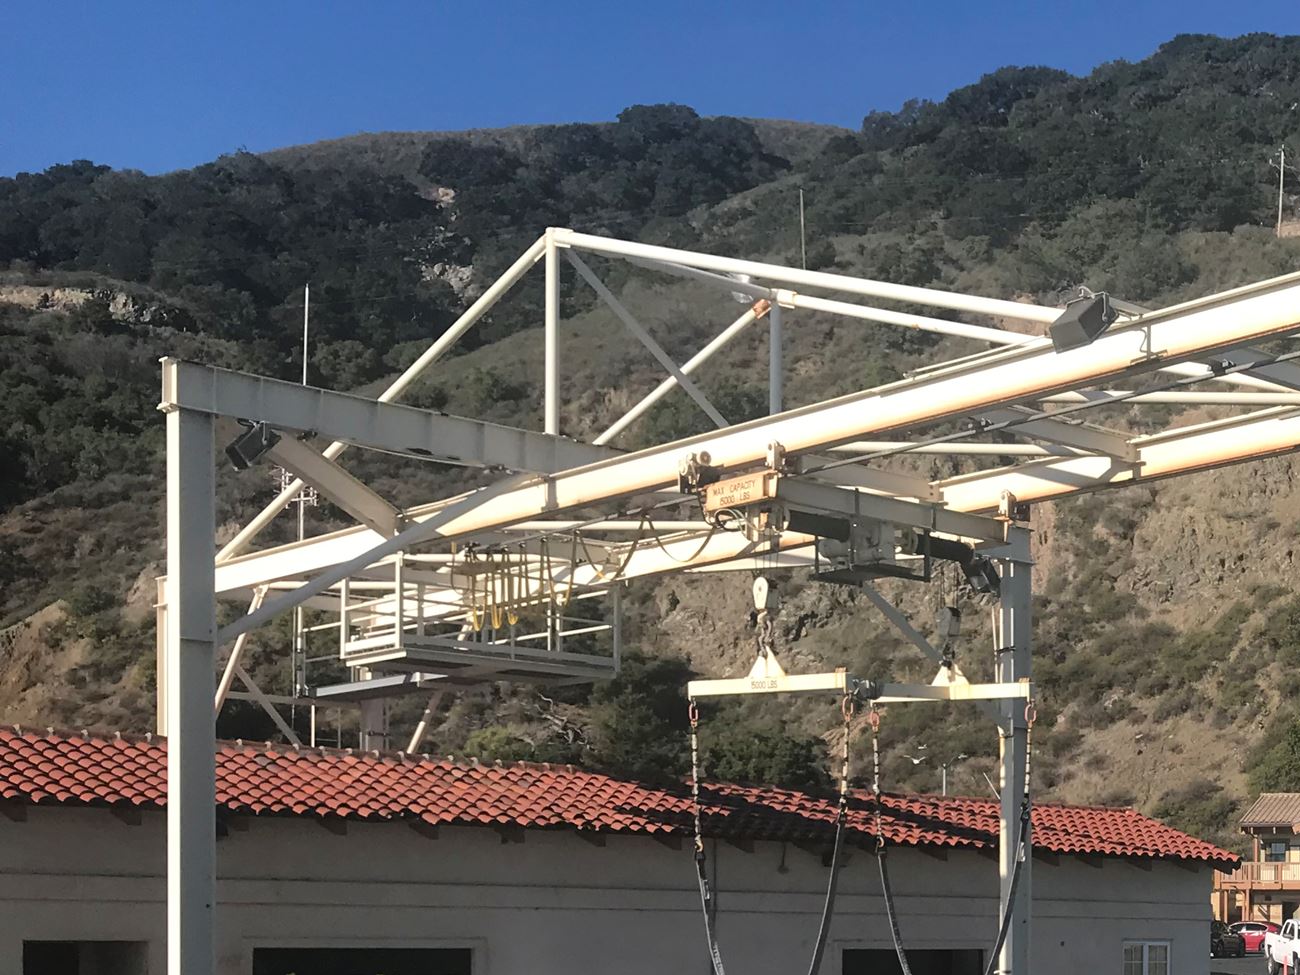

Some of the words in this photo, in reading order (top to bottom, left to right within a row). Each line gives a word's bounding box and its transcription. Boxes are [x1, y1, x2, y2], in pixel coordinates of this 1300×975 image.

[713, 487, 725, 496] MAX
[729, 479, 756, 493] CAPACITY
[740, 490, 750, 501] LBS
